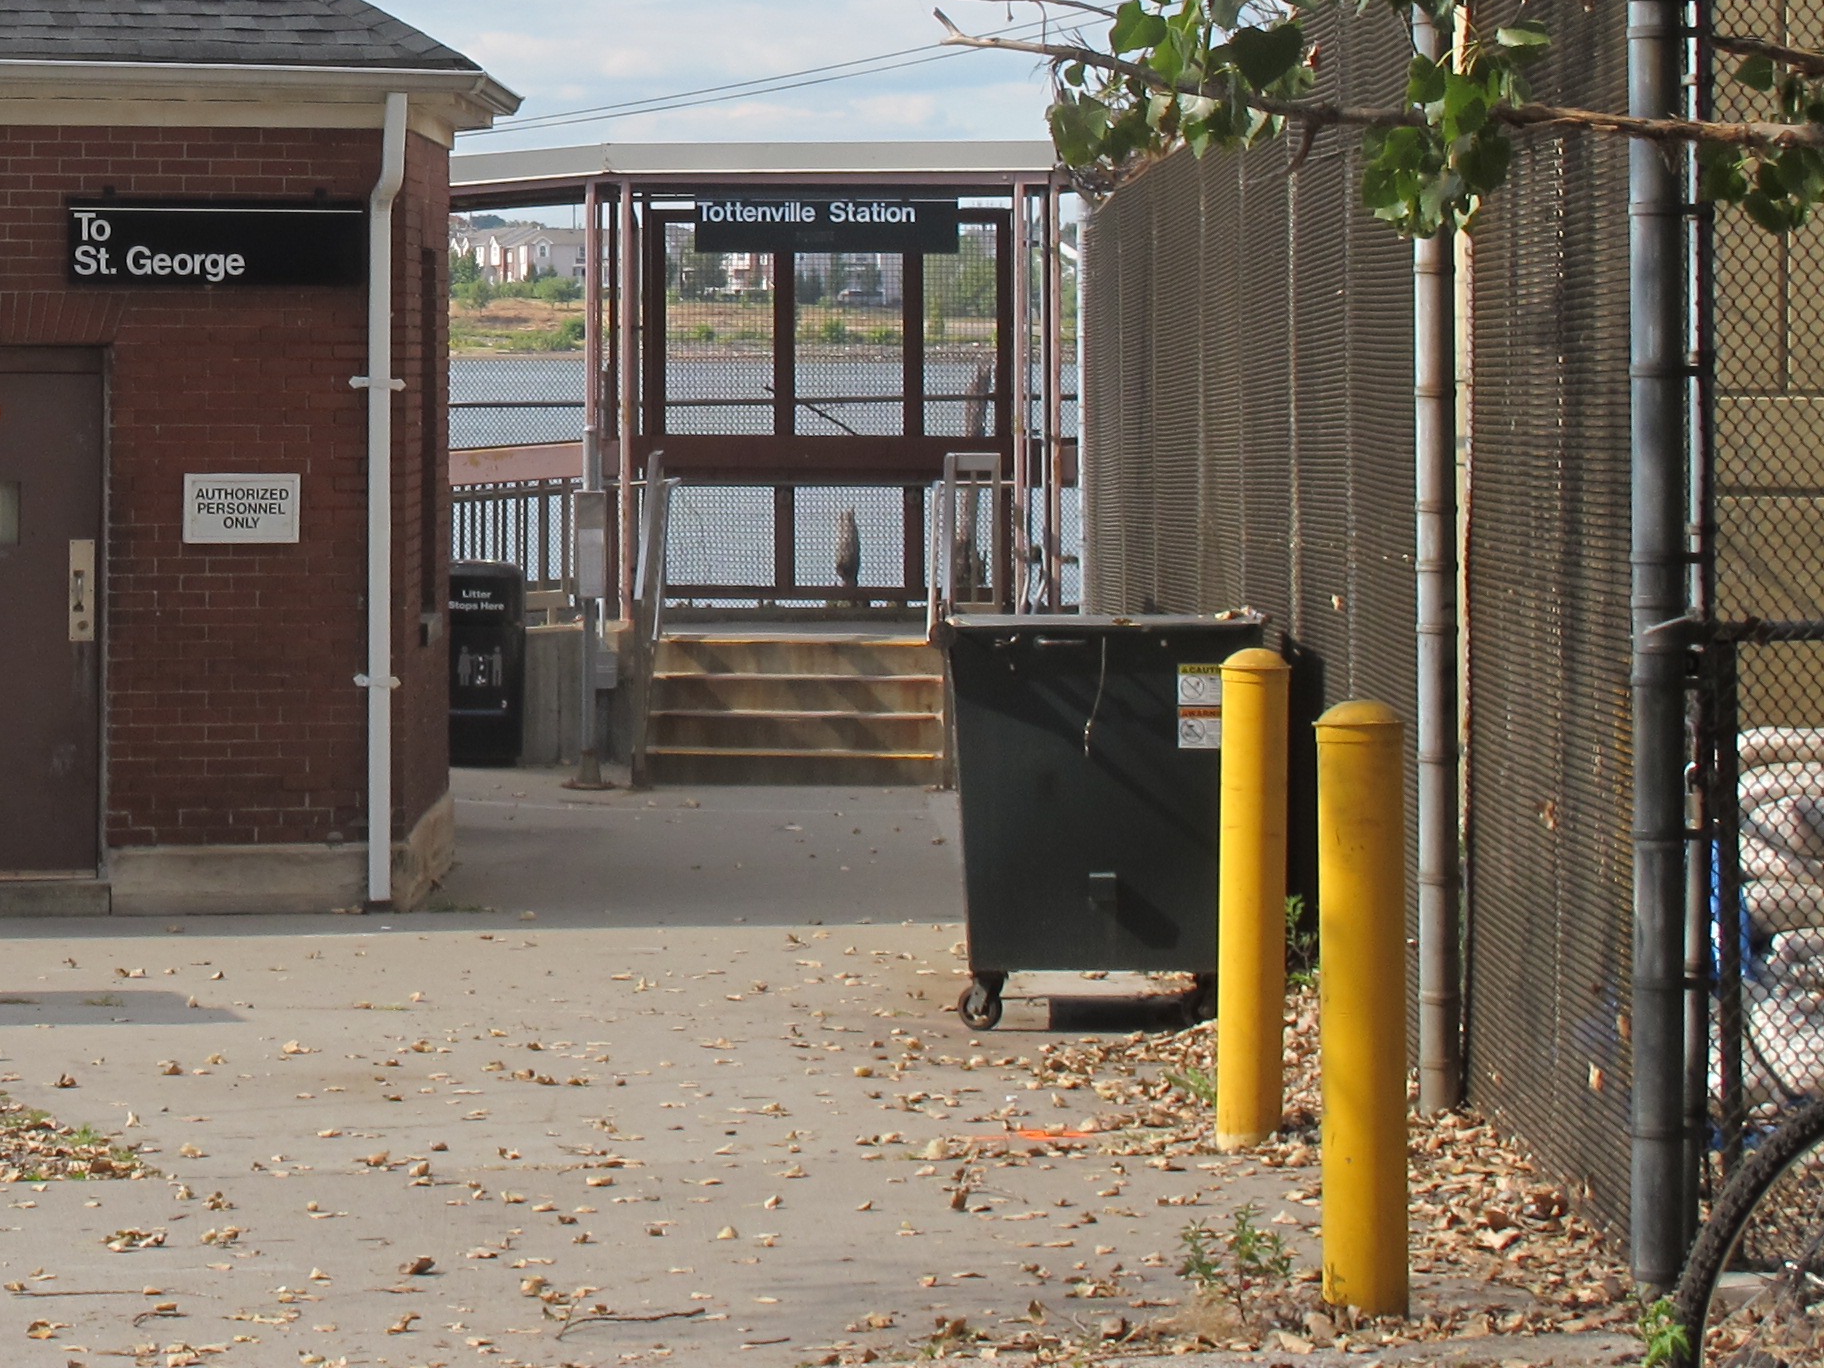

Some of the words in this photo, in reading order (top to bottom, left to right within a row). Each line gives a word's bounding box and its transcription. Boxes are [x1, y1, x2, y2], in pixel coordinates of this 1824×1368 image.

[697, 201, 816, 223] Tottenville
[829, 201, 916, 223] Station
[73, 212, 111, 241] To
[73, 245, 117, 275] St.
[126, 245, 246, 282] George
[195, 488, 289, 500] AUTHORIZED
[197, 502, 286, 514] PERSONNEL
[223, 516, 260, 529] ONLY
[462, 589, 492, 599] Litter
[448, 601, 478, 611] Stops
[480, 601, 505, 611] Here
[1189, 666, 1221, 674] CAUT
